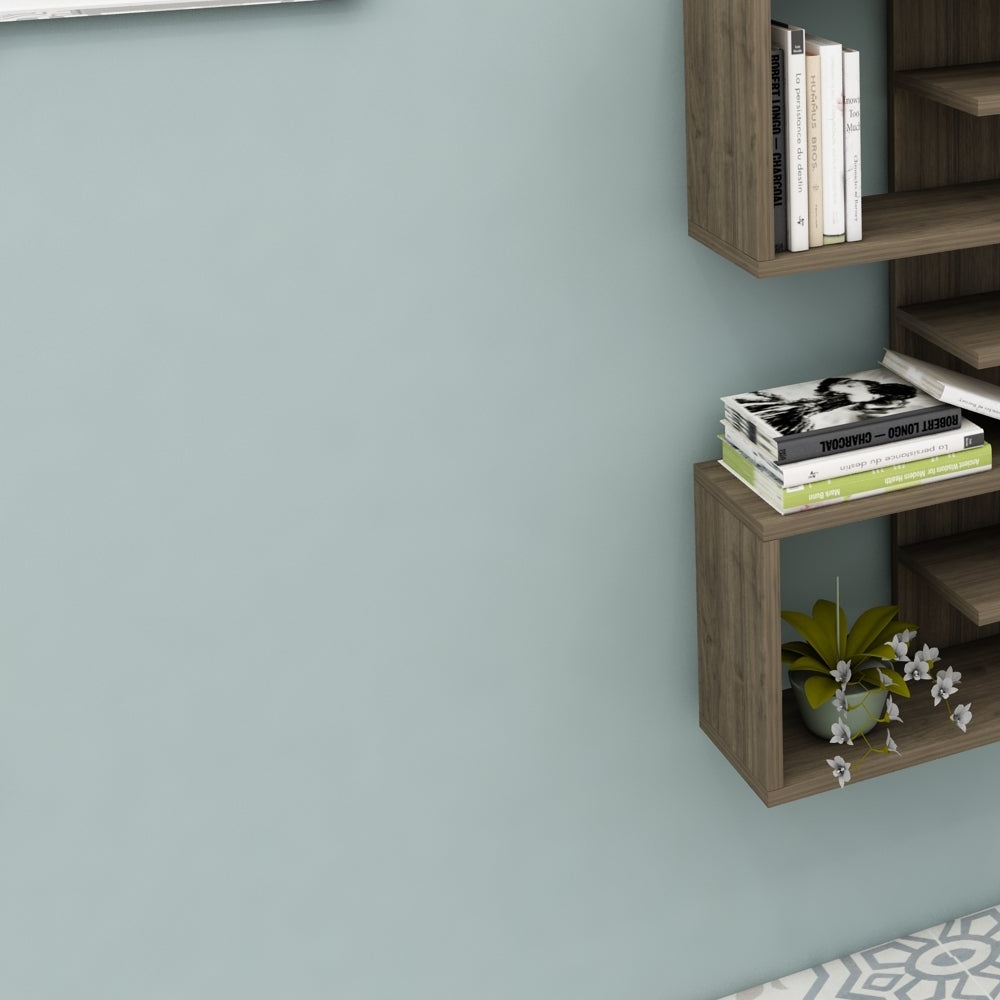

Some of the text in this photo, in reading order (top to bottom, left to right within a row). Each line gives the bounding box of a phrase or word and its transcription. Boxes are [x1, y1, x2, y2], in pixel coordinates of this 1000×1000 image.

[771, 55, 780, 96] ROBERT
[796, 73, 801, 84] La
[810, 75, 818, 129] HUMMUS
[797, 147, 803, 160] du
[922, 414, 959, 431] ROBERT
[888, 423, 920, 439] LONGO
[820, 431, 872, 453] CHARCOAL
[885, 446, 935, 462] persistance
[840, 460, 867, 471] destin
[870, 458, 882, 466] du
[935, 461, 958, 473] Wisdom
[958, 456, 980, 468] Ancient
[884, 474, 903, 485] Health
[903, 469, 926, 480] Modern
[824, 488, 840, 498] Mark
